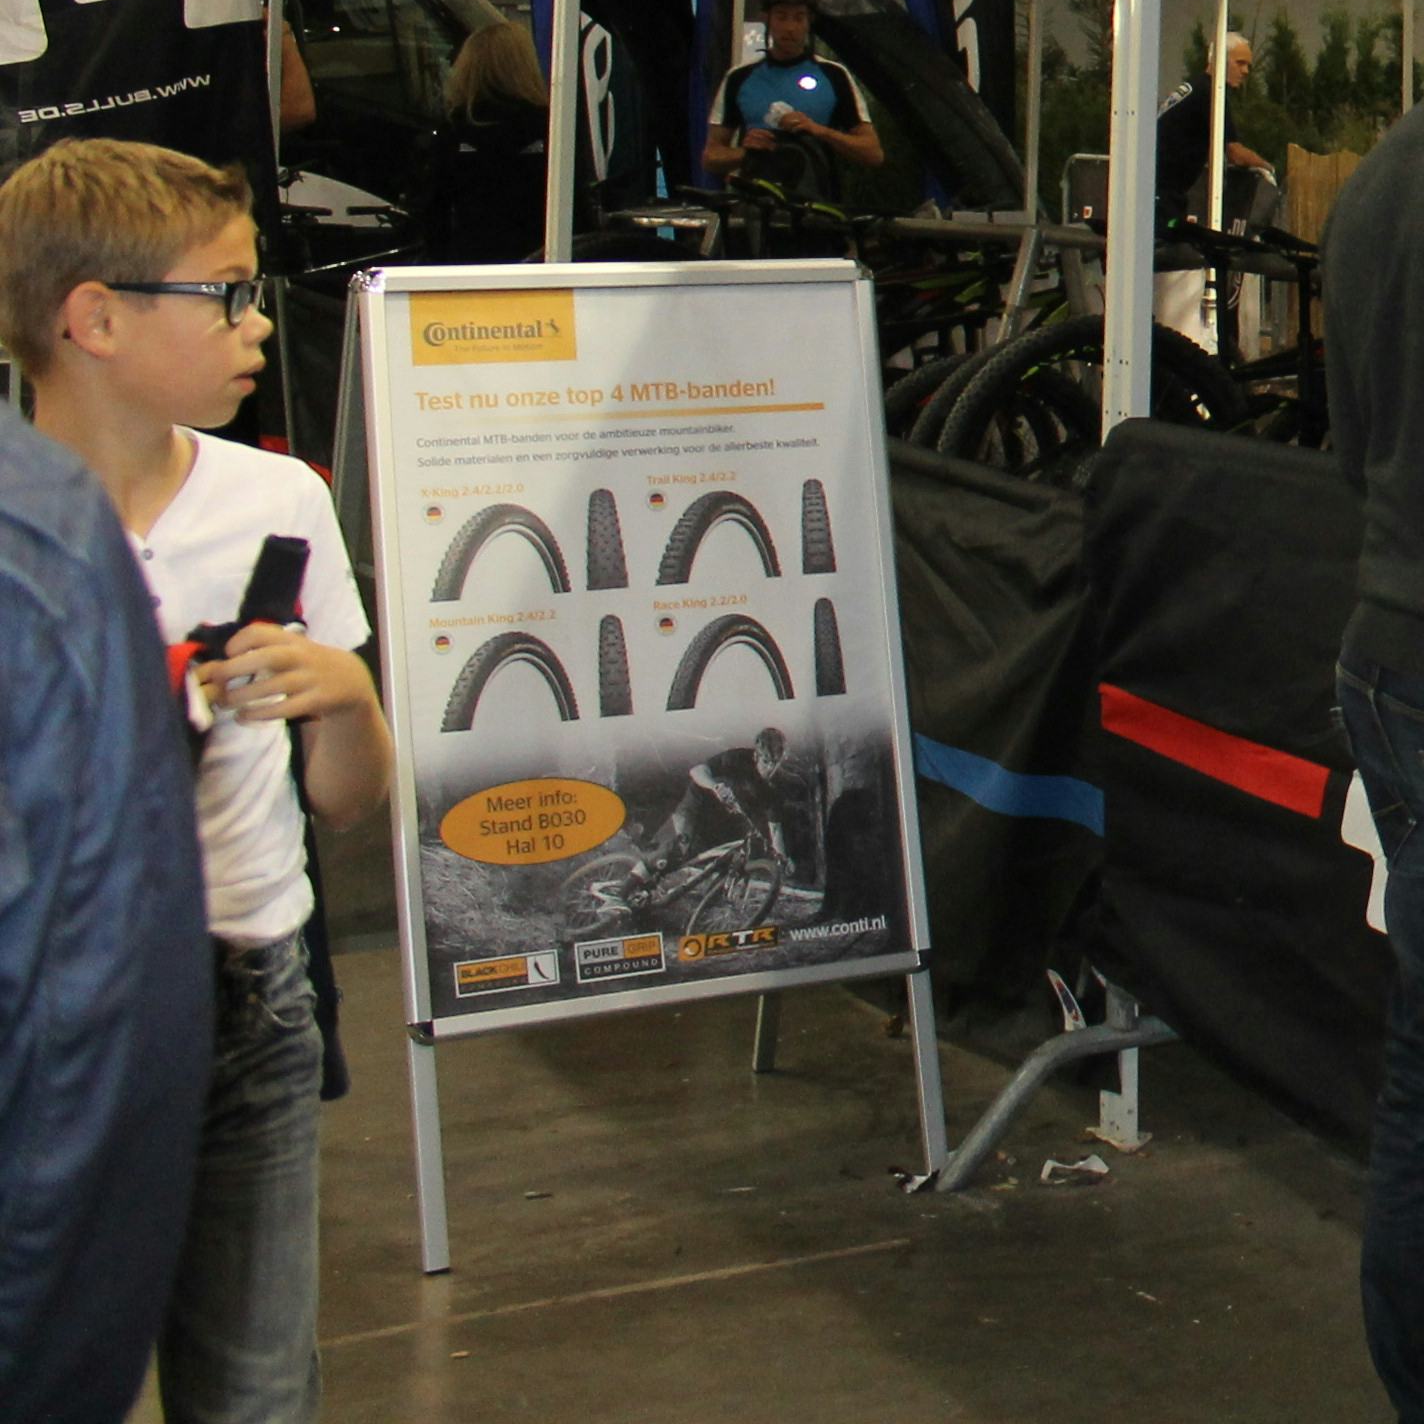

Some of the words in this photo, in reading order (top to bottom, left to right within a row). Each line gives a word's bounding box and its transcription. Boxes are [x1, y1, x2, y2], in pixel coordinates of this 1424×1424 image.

[423, 319, 543, 347] Continental
[415, 391, 462, 411] Test
[470, 391, 498, 409] nu
[506, 390, 559, 407] onze
[566, 386, 604, 408] top
[610, 384, 625, 402] 4
[630, 379, 775, 402] MTB-banden!
[416, 436, 481, 448] Continental
[483, 432, 551, 445] MTB-banden
[554, 432, 580, 441] voor
[582, 430, 597, 440] de
[599, 426, 657, 439] ambitieuze
[417, 456, 452, 468] Solide
[454, 452, 513, 465] materialen
[516, 453, 530, 462] en
[532, 451, 553, 461] een
[555, 447, 619, 462] zorgvuldige
[621, 444, 681, 459] verwerking
[682, 445, 706, 454] voor
[708, 441, 722, 452] de
[724, 438, 773, 451] allerbeste
[672, 473, 696, 485] King
[653, 599, 680, 610] Race
[683, 597, 707, 609] King
[710, 595, 747, 607] 2.2/2.0
[429, 616, 485, 627] Mountain
[488, 613, 515, 625] King
[517, 610, 556, 622] 2.4/2.2
[486, 796, 533, 812] Meer
[539, 790, 577, 807] info:
[480, 816, 533, 836] Stand
[538, 809, 586, 830] B030
[506, 839, 536, 855] Hal
[543, 834, 565, 850] 10
[708, 927, 775, 949] RTR
[789, 915, 886, 942] www.conti.nl
[583, 945, 619, 960] PURE
[584, 958, 658, 976] COMPOUND
